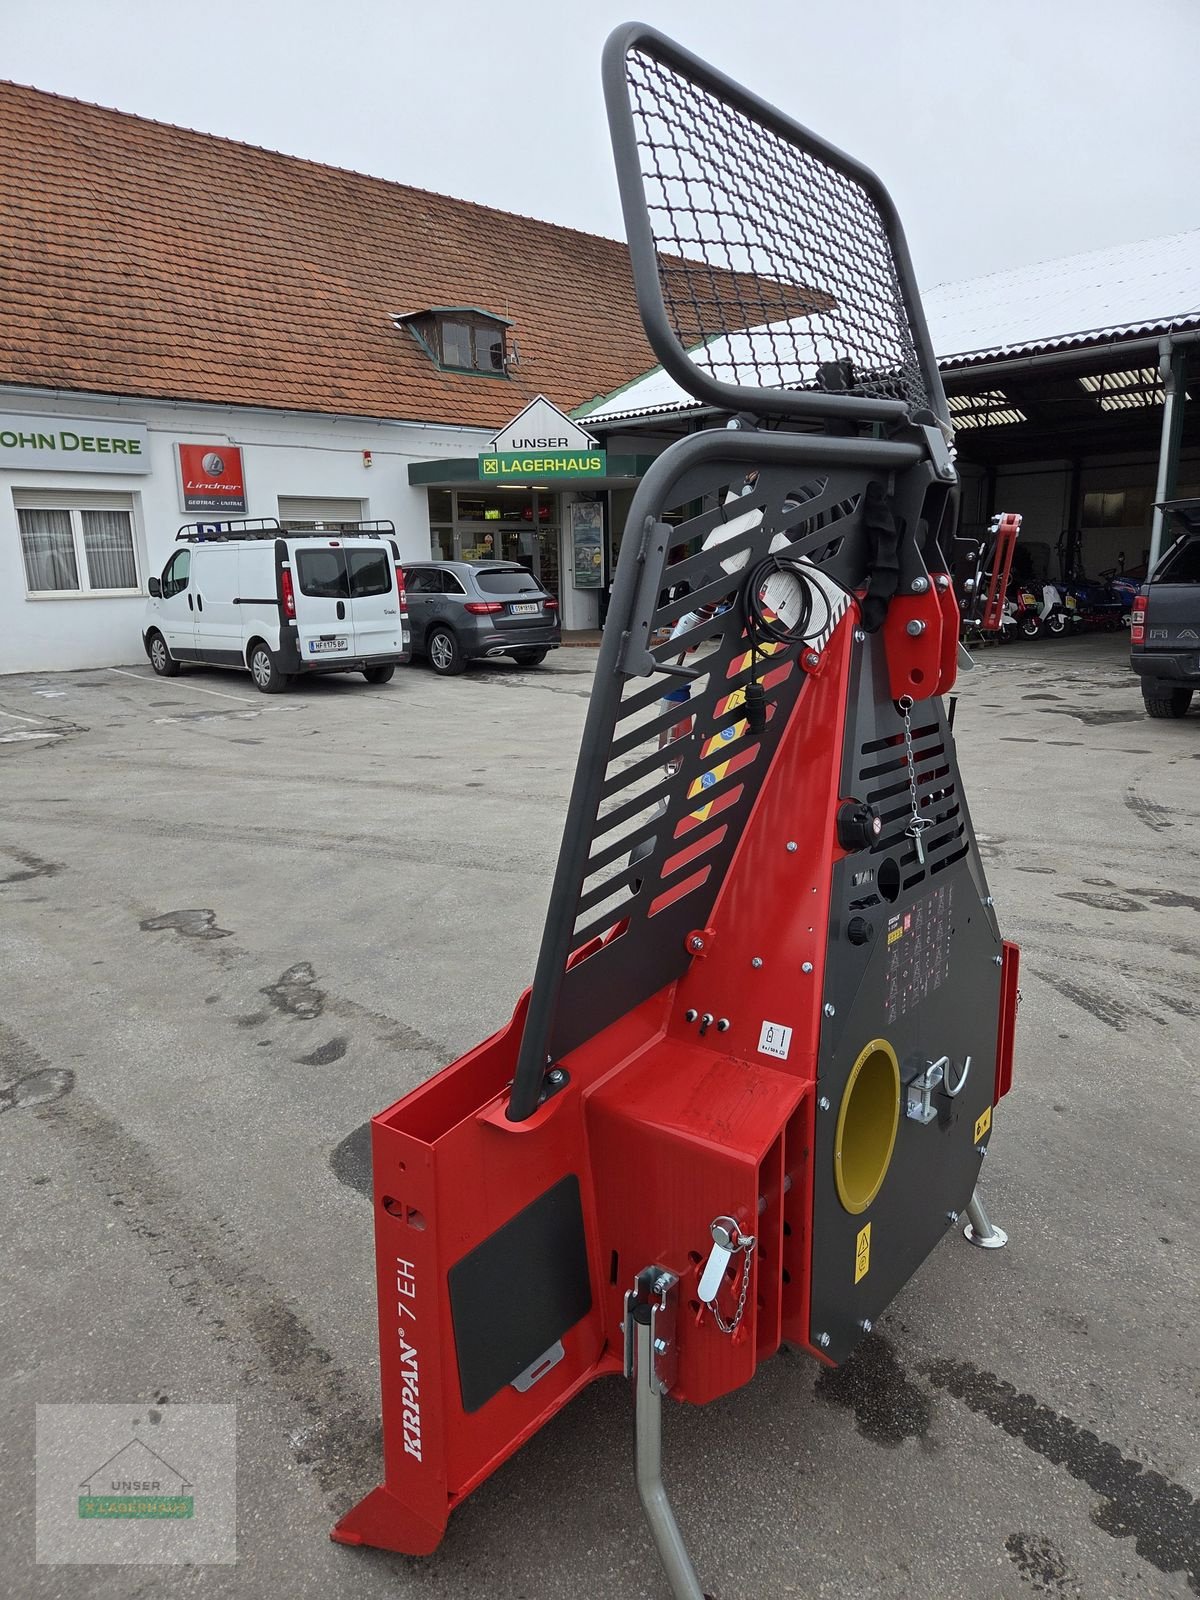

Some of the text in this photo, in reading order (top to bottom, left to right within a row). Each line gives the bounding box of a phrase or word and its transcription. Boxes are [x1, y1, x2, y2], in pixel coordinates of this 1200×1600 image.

[60, 432, 142, 454] DEERE
[512, 437, 568, 448] UNSER
[501, 458, 601, 472] LAGERHAUS
[186, 481, 241, 490] Lindner
[396, 1257, 416, 1299] EH
[398, 1301, 416, 1321] 7
